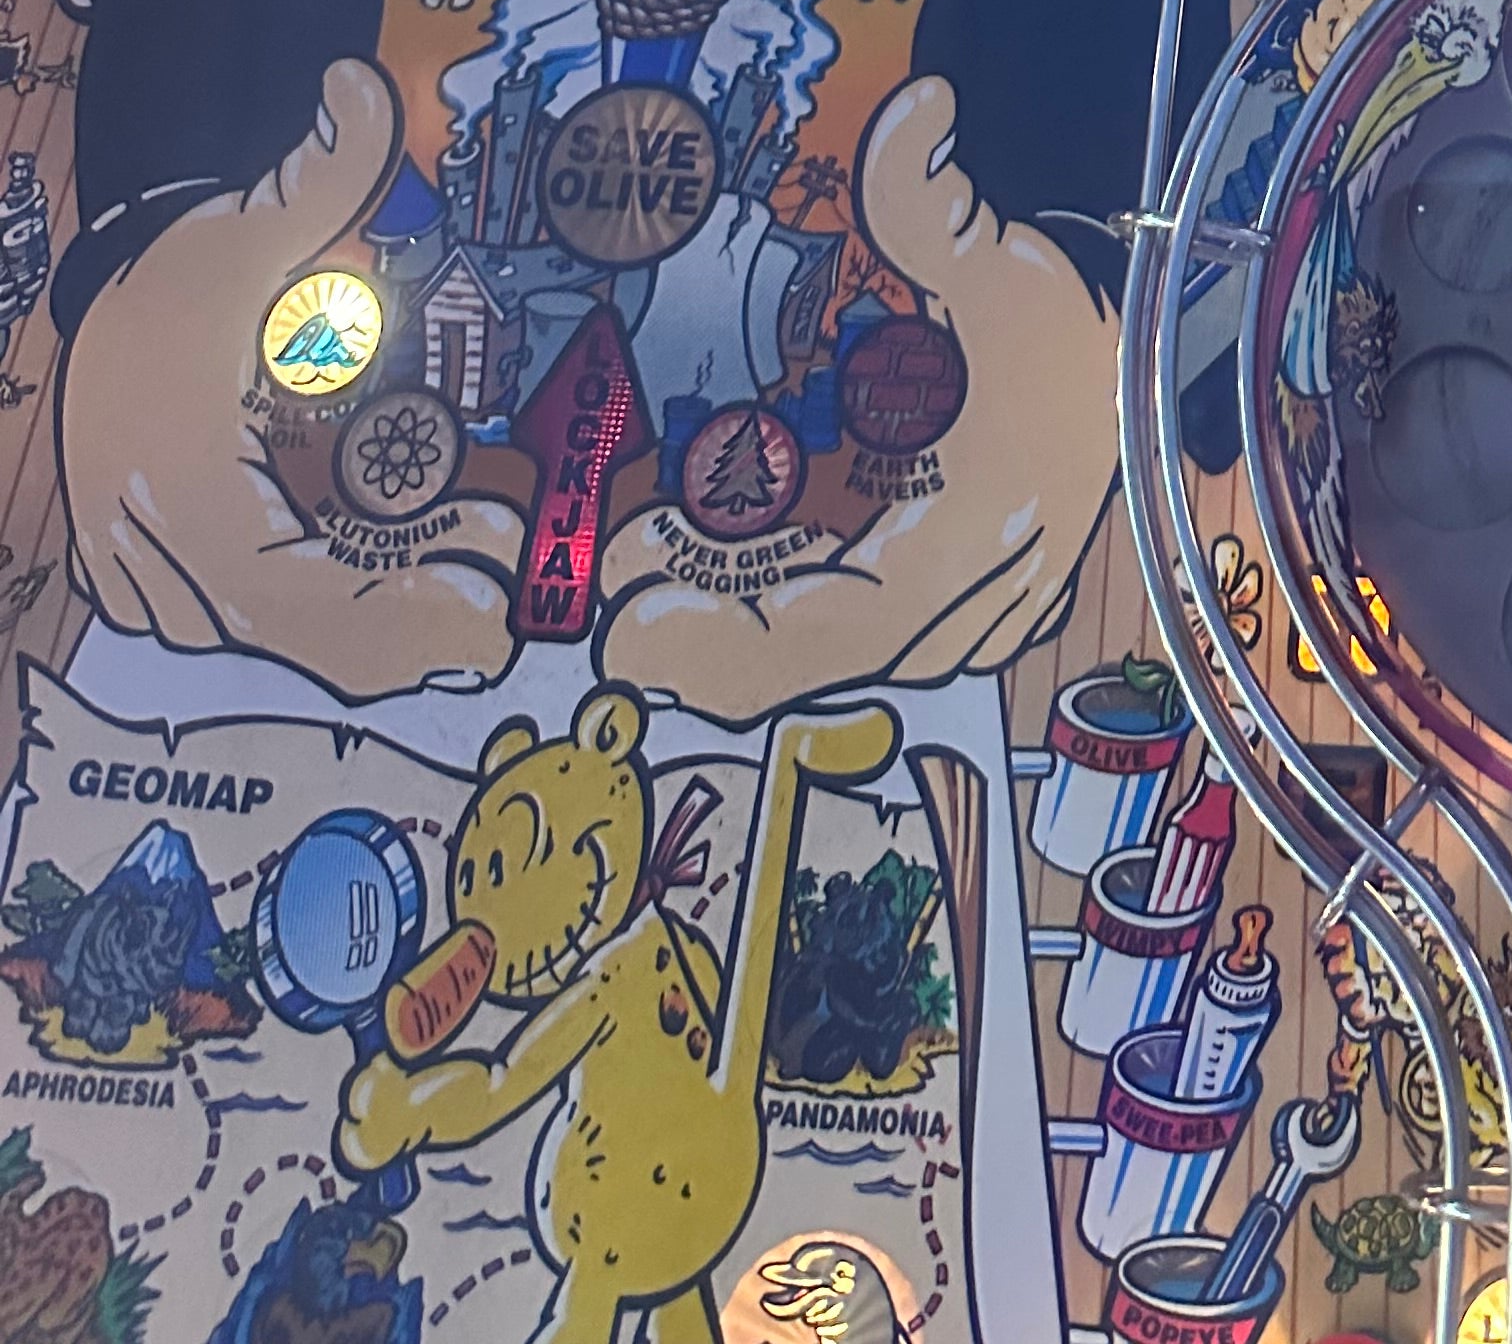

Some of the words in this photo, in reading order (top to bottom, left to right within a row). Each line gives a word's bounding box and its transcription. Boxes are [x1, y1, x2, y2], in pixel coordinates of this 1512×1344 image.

[568, 124, 701, 171] SAVE
[550, 167, 704, 215] OLIVE
[852, 449, 941, 476] EARTH
[844, 471, 946, 501] PAVERS
[327, 538, 413, 572] WASTE
[651, 511, 731, 570] NEVER
[736, 519, 826, 570] GREEN
[665, 552, 782, 595] LOGGING
[1071, 734, 1149, 769] OLIVE
[68, 758, 275, 814] GEOMAP
[2, 1069, 176, 1110] APHRODESIA
[766, 1099, 946, 1139] PANDAMONIA
[1121, 1305, 1235, 1344] POPEYE
